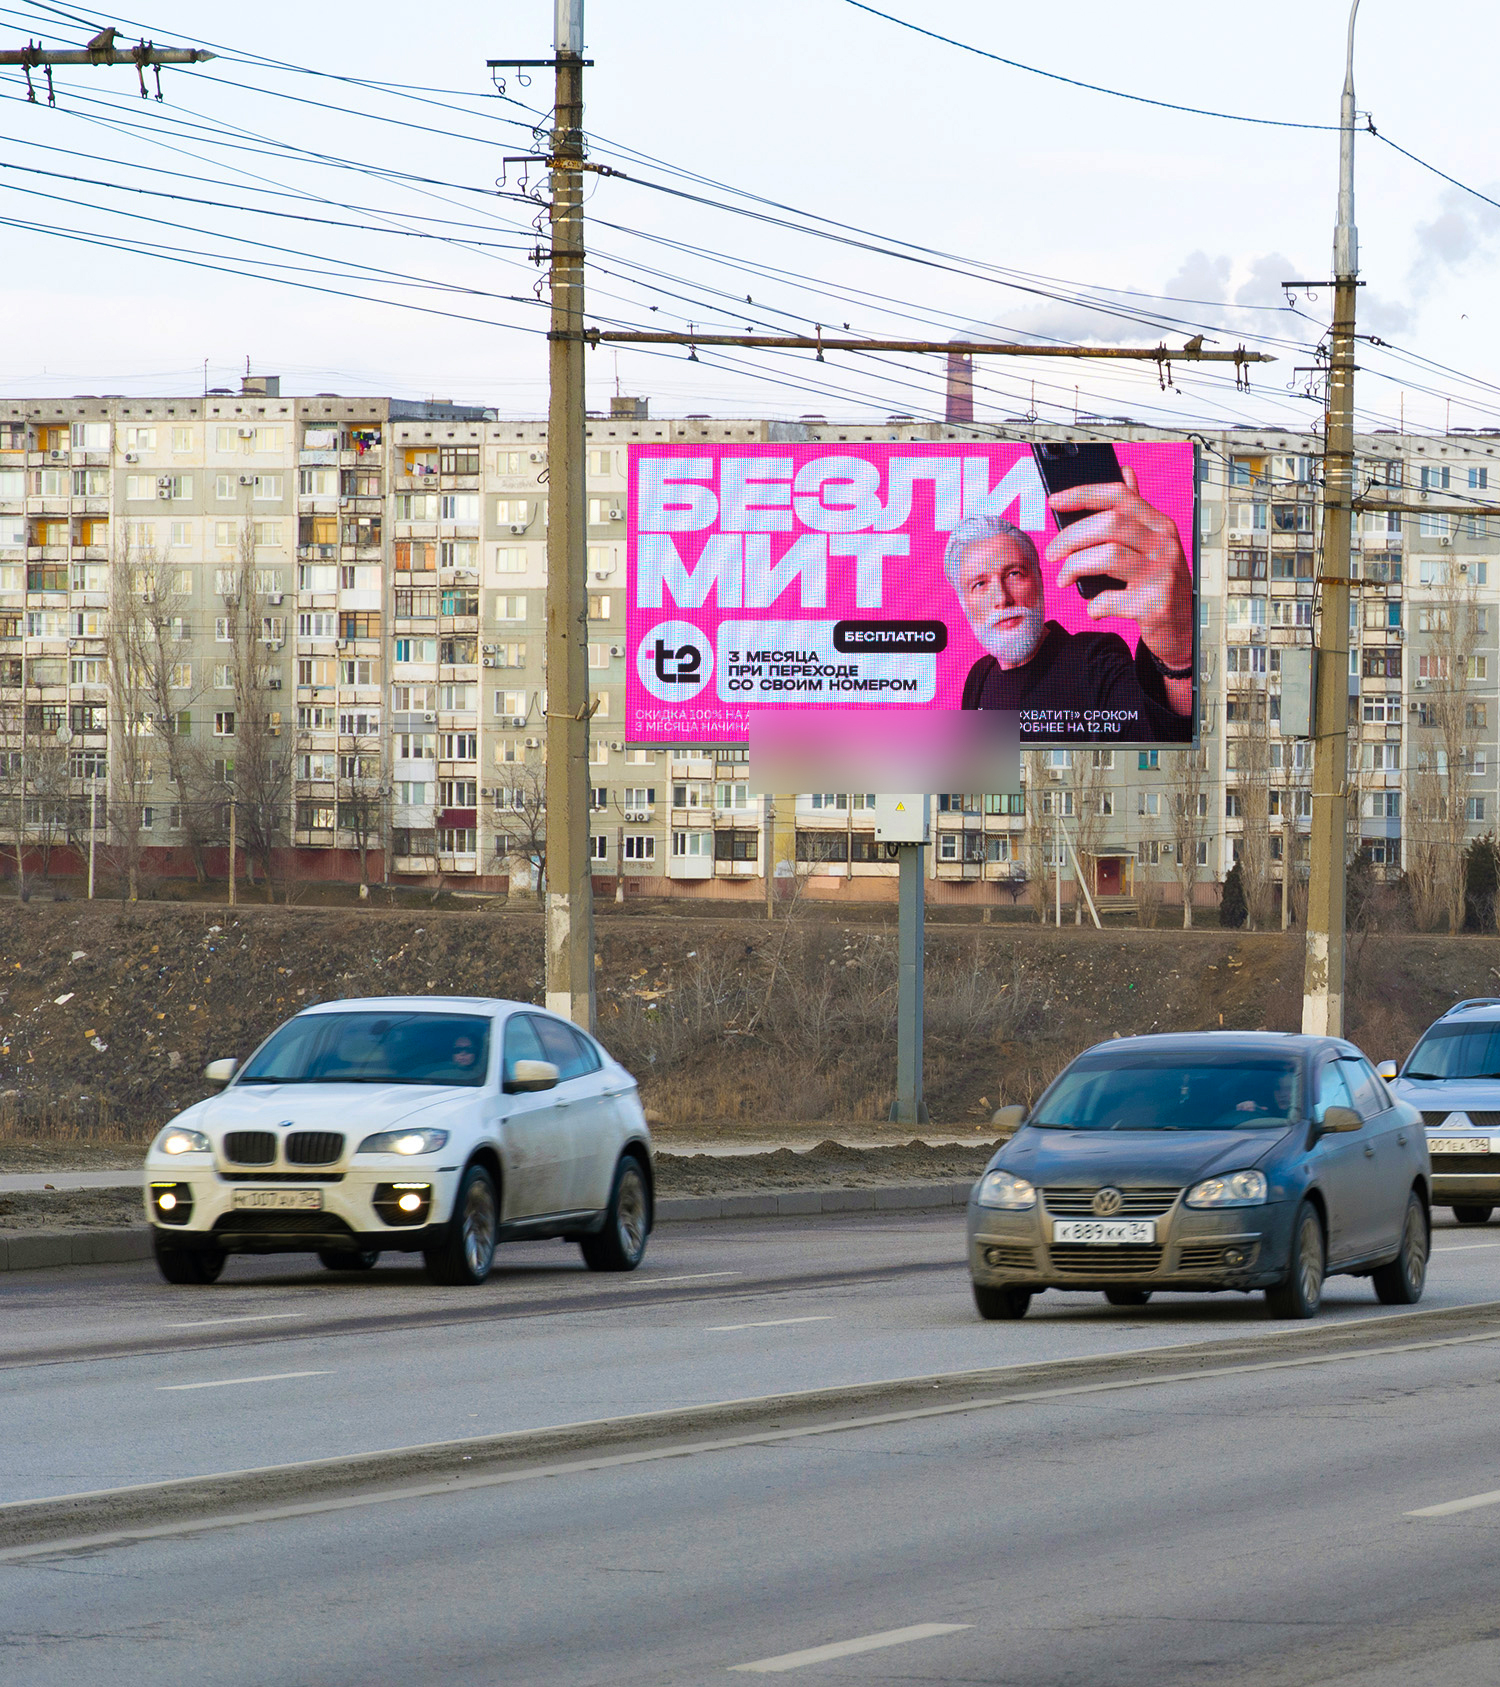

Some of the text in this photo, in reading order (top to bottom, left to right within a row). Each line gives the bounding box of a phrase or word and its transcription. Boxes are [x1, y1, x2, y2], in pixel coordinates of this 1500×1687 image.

[638, 456, 1046, 532] БЕЗЛИ
[637, 533, 910, 608] МИТ
[844, 631, 936, 642] БЕСПЛАТНО
[655, 639, 701, 684] t2
[728, 651, 819, 664] 3 МЕСЯЦА
[728, 665, 858, 678] ПРИ ПЕРЕХОДЕ
[728, 679, 918, 691] СО СВОИМ НОМЕРОМ
[635, 709, 688, 721] СКИДКА
[690, 709, 722, 720] 100%
[725, 709, 743, 720] НА
[1084, 710, 1139, 721] СРОКОМ
[635, 721, 642, 732] 3
[646, 721, 699, 733] МЕСЯЦА
[1067, 722, 1085, 732] НА
